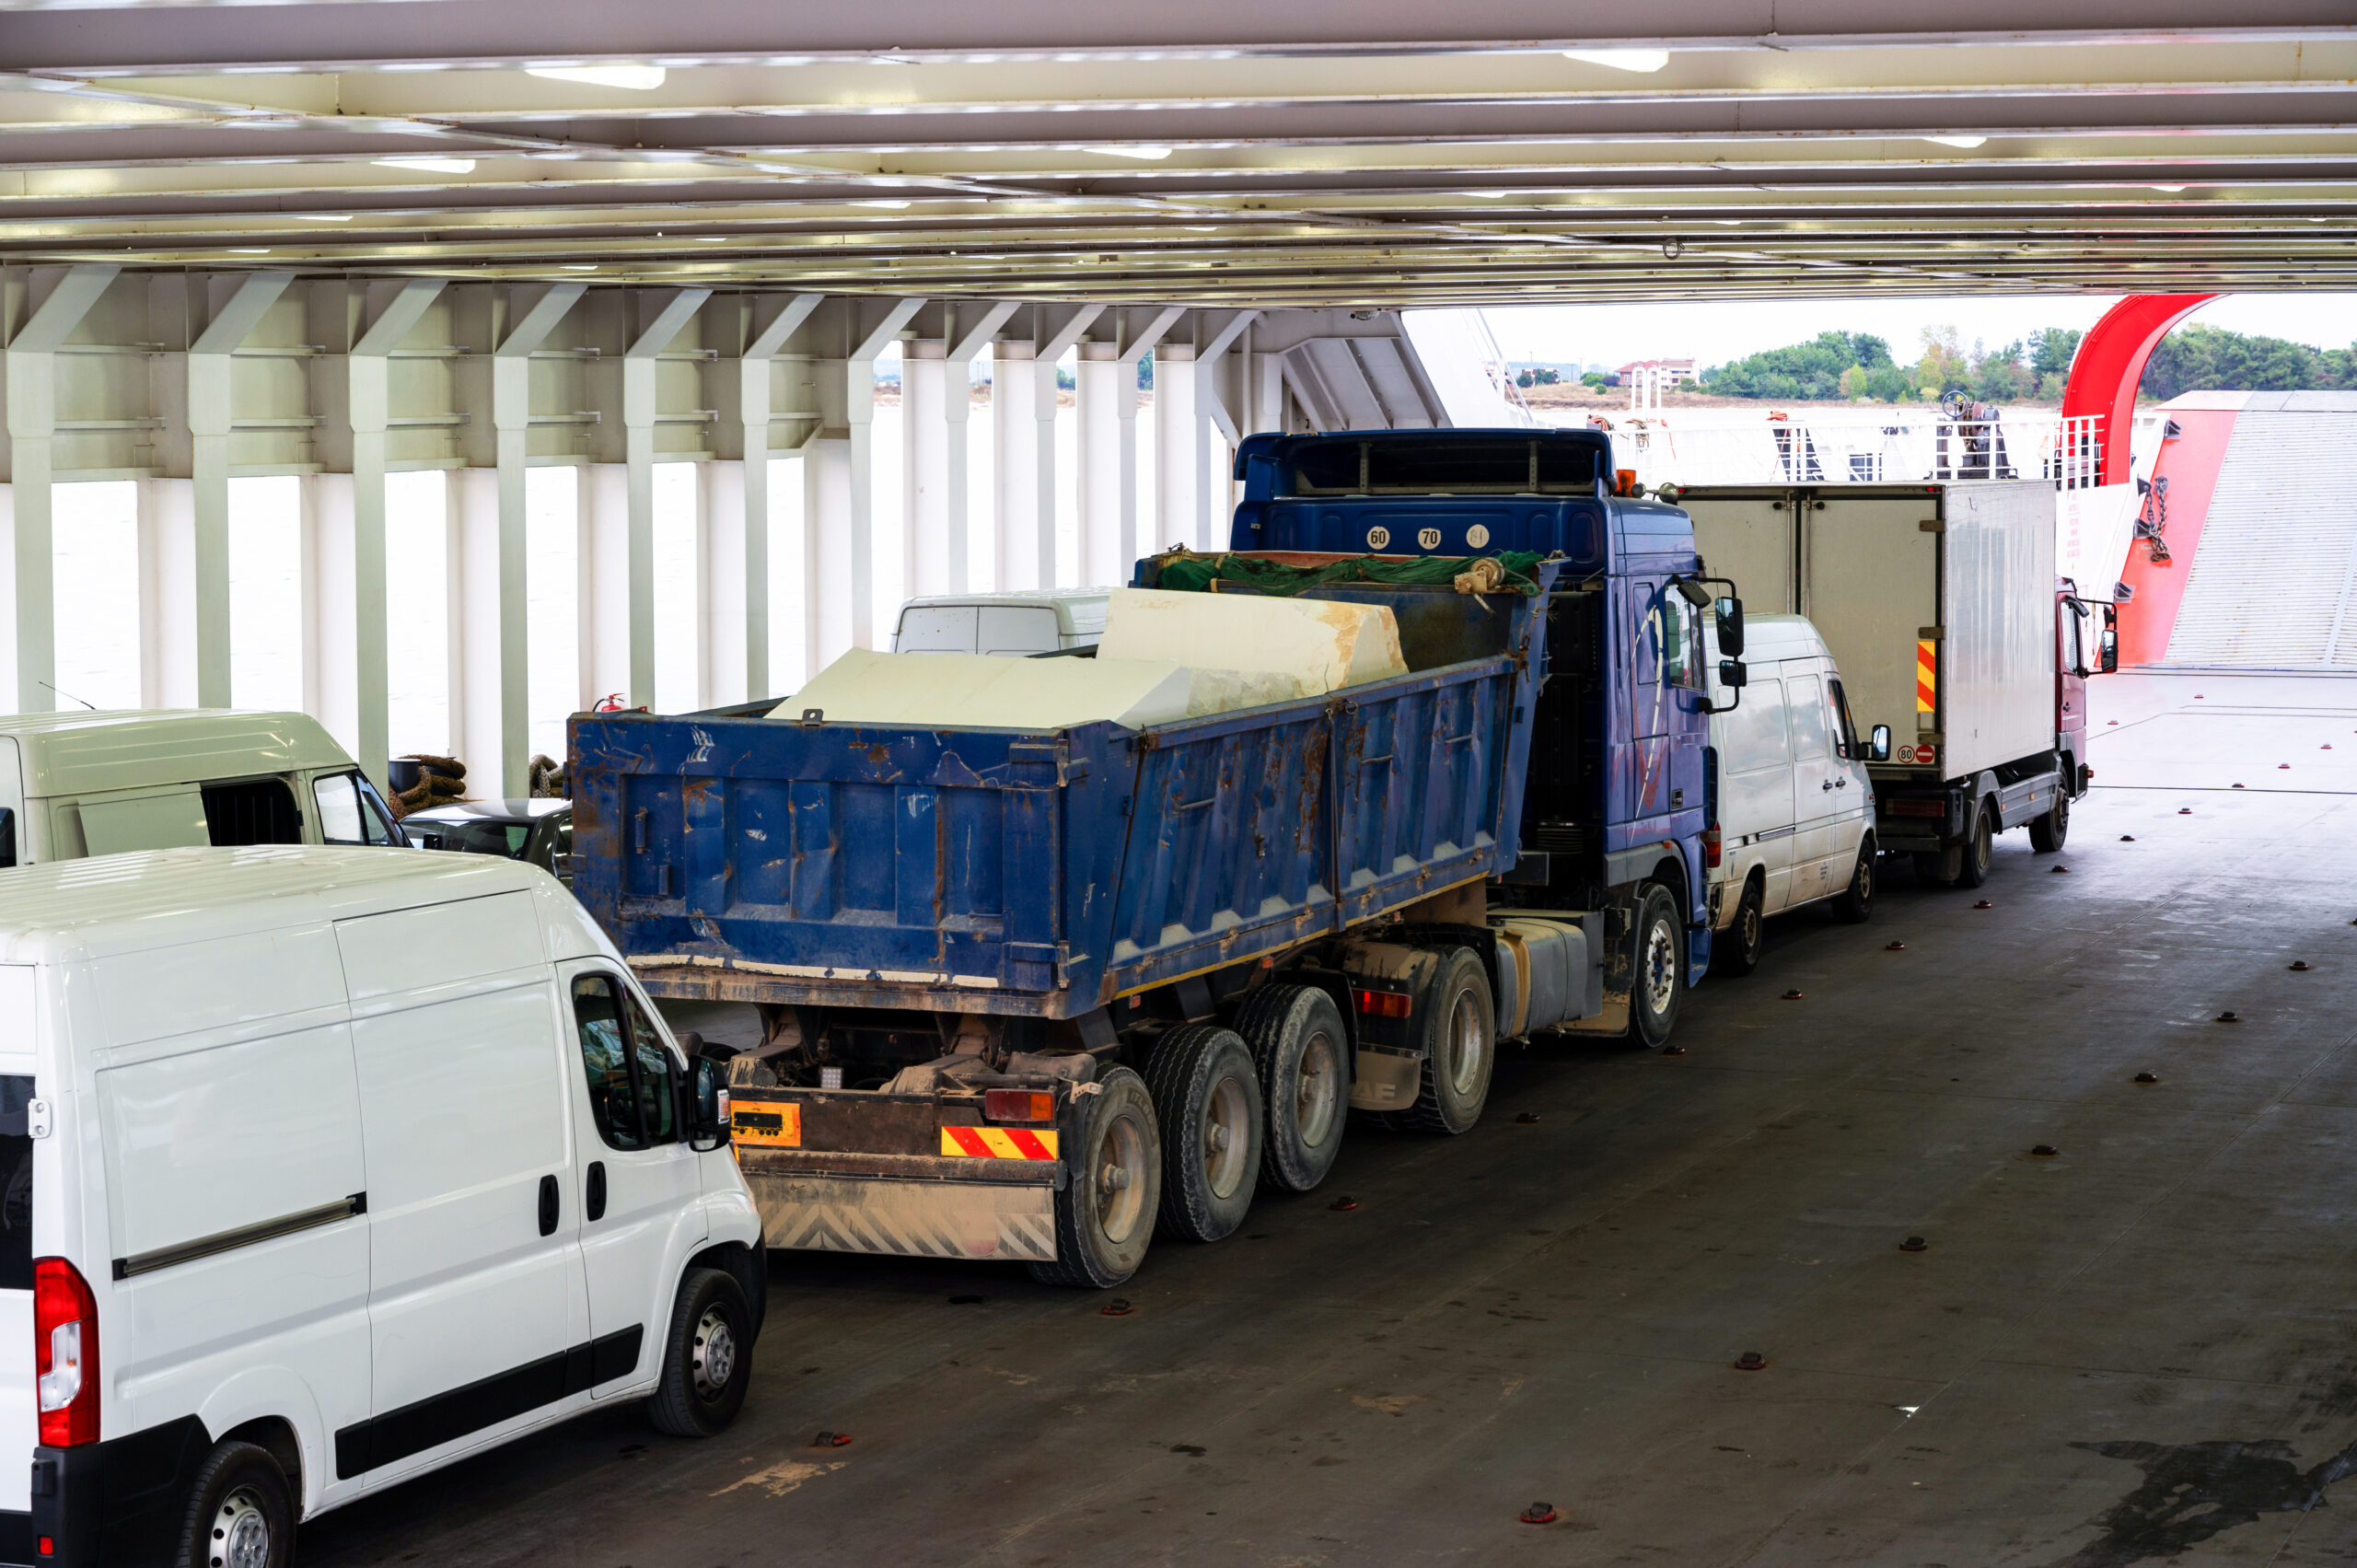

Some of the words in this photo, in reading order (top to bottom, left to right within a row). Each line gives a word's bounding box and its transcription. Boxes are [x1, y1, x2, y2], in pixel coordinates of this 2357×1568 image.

[1371, 530, 1386, 544] 60
[1422, 530, 1437, 544] 70
[1900, 749, 1912, 760] 80
[1349, 1082, 1396, 1100] AF
